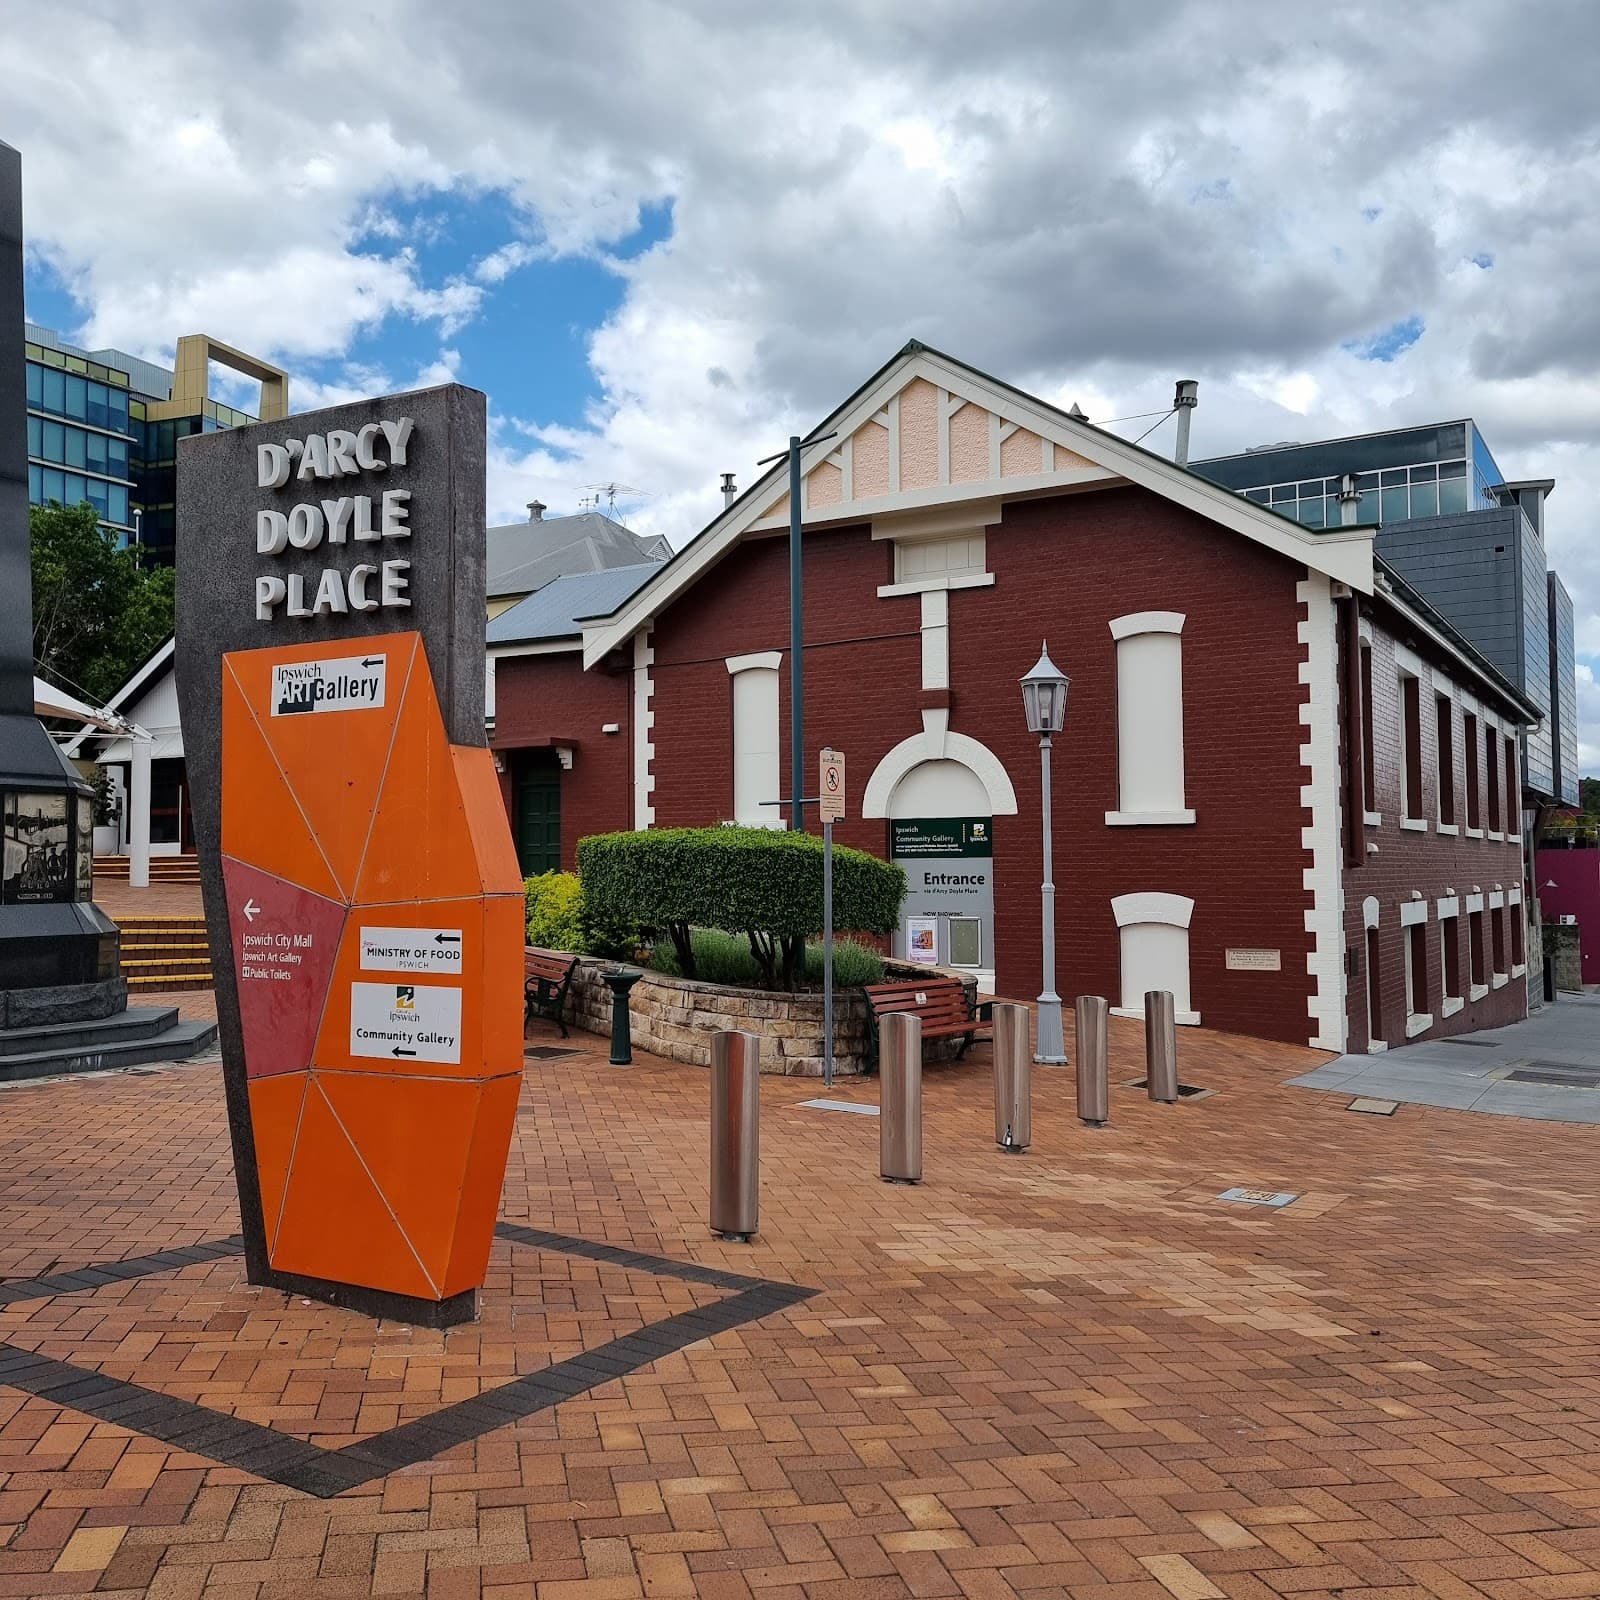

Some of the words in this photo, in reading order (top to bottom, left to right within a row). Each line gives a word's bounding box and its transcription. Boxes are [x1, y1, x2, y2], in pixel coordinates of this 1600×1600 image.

[258, 417, 414, 488] D'ARCY
[257, 489, 411, 554] DOYLE
[256, 559, 411, 621] PLACE
[278, 663, 321, 683] Ipswich
[895, 826, 919, 834] Ipswich
[895, 835, 931, 843] Community
[931, 834, 954, 843] Gallery
[924, 872, 985, 885] Entrance
[242, 932, 273, 948] Ipswich
[275, 934, 291, 950] City
[293, 934, 313, 948] Mall
[242, 951, 265, 962] Ipswich
[267, 952, 278, 962] Art
[279, 952, 302, 965] Gallery
[367, 948, 411, 958] MINISTRY
[414, 949, 427, 959] OF
[430, 950, 460, 960] FOOD
[396, 960, 429, 969] IPSWICH
[250, 968, 269, 979] Public
[270, 969, 291, 980] Toilets
[389, 1010, 420, 1023] Ipswich
[356, 1028, 413, 1044] Community
[417, 1033, 455, 1047] Gallery
